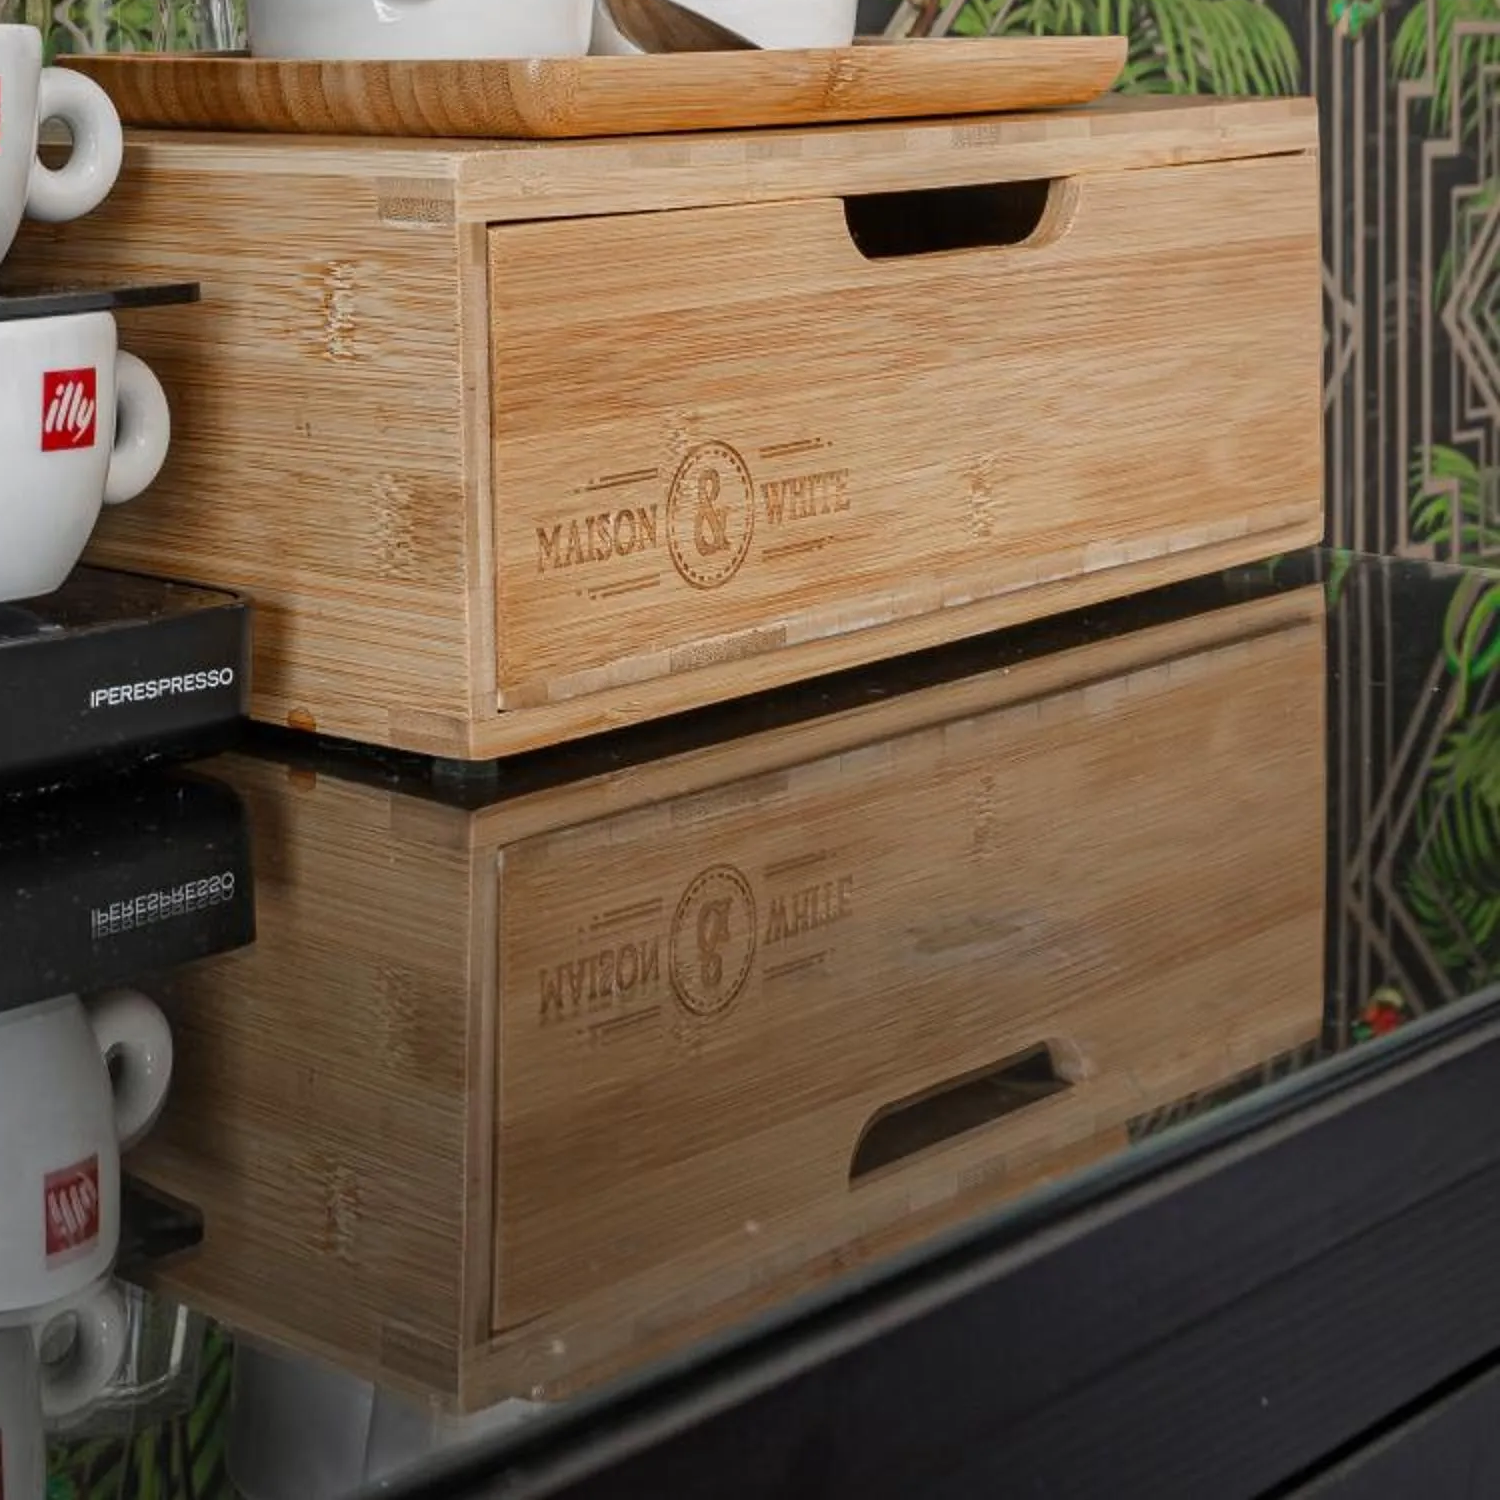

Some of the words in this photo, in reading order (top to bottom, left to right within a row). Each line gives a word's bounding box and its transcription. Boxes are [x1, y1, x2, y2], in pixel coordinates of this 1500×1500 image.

[44, 380, 95, 444] illy
[535, 503, 658, 574] MAISON
[693, 467, 732, 557] &
[760, 467, 850, 526] WHITE
[90, 666, 234, 709] IPERESPRESSO
